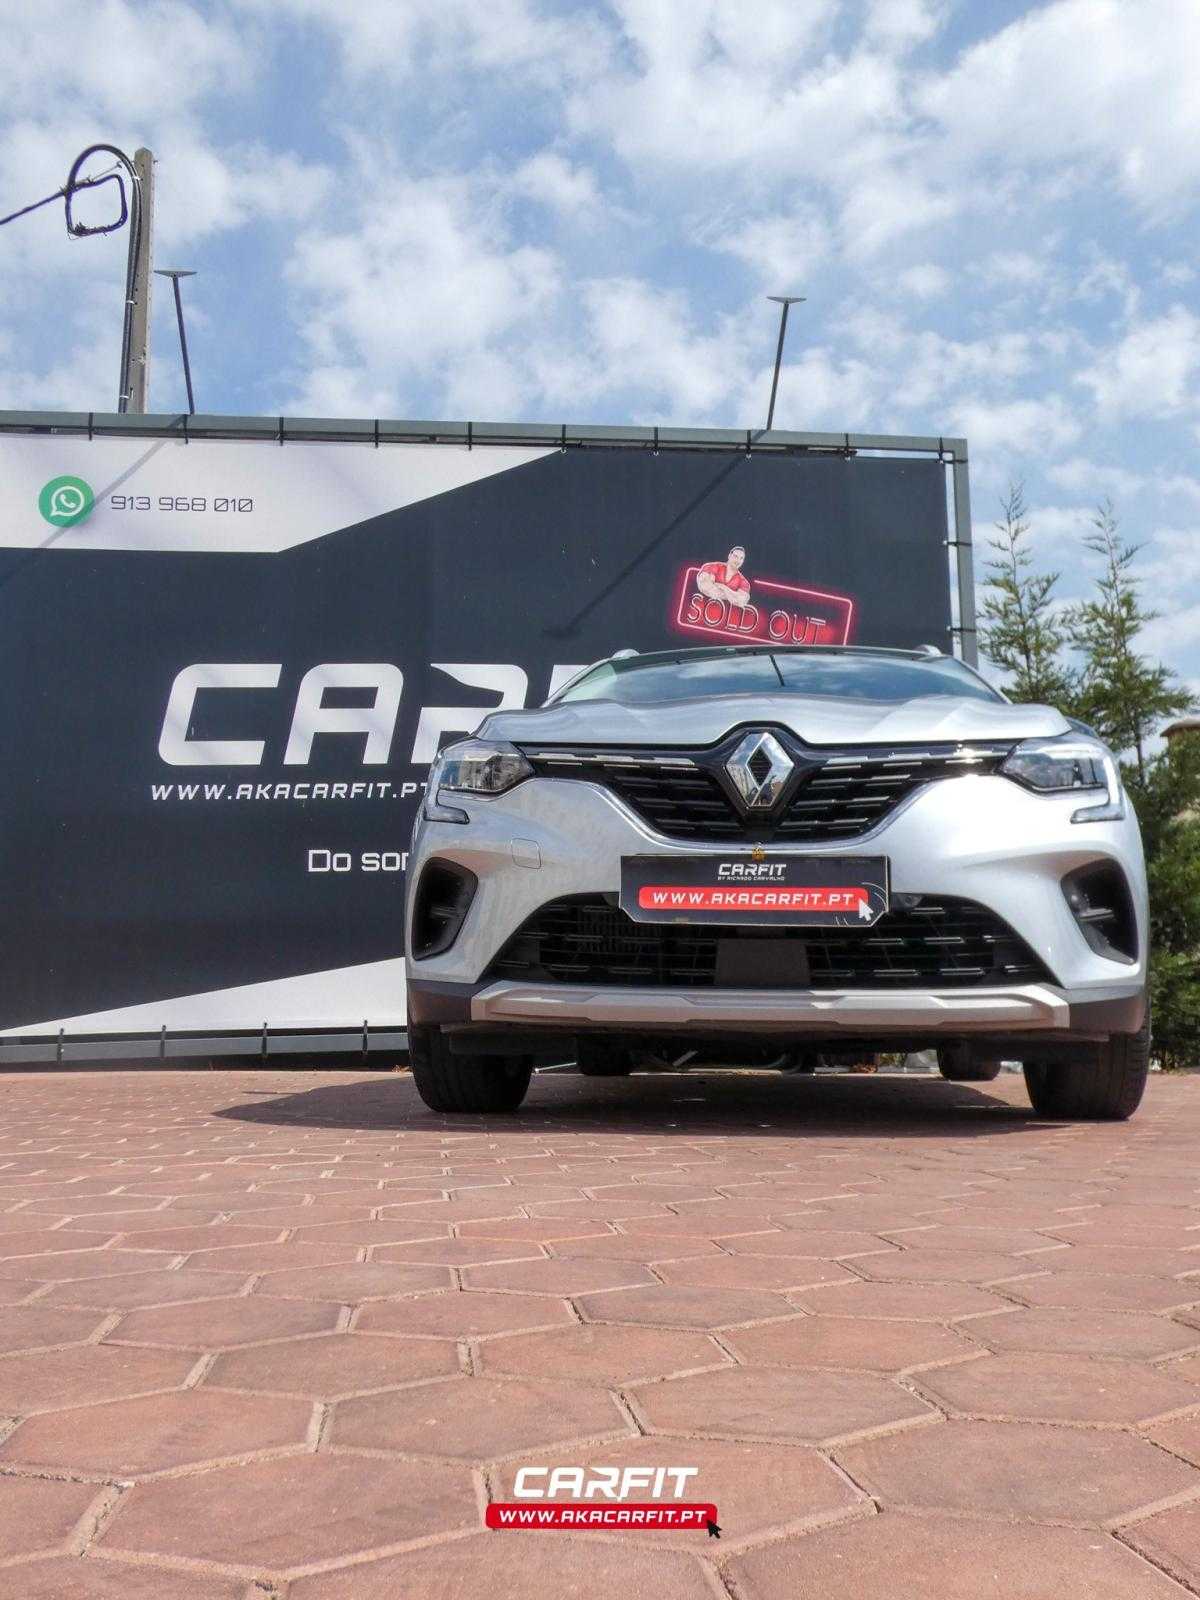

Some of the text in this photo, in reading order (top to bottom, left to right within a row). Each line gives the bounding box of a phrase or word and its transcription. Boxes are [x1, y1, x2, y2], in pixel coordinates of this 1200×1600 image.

[111, 495, 253, 512] 913 968 010
[687, 593, 826, 645] SOLD OUT
[158, 663, 589, 766] CAR
[308, 849, 352, 872] Do
[718, 863, 787, 876] CARFIT
[653, 891, 855, 906] WWW.AKACARFIT.PT
